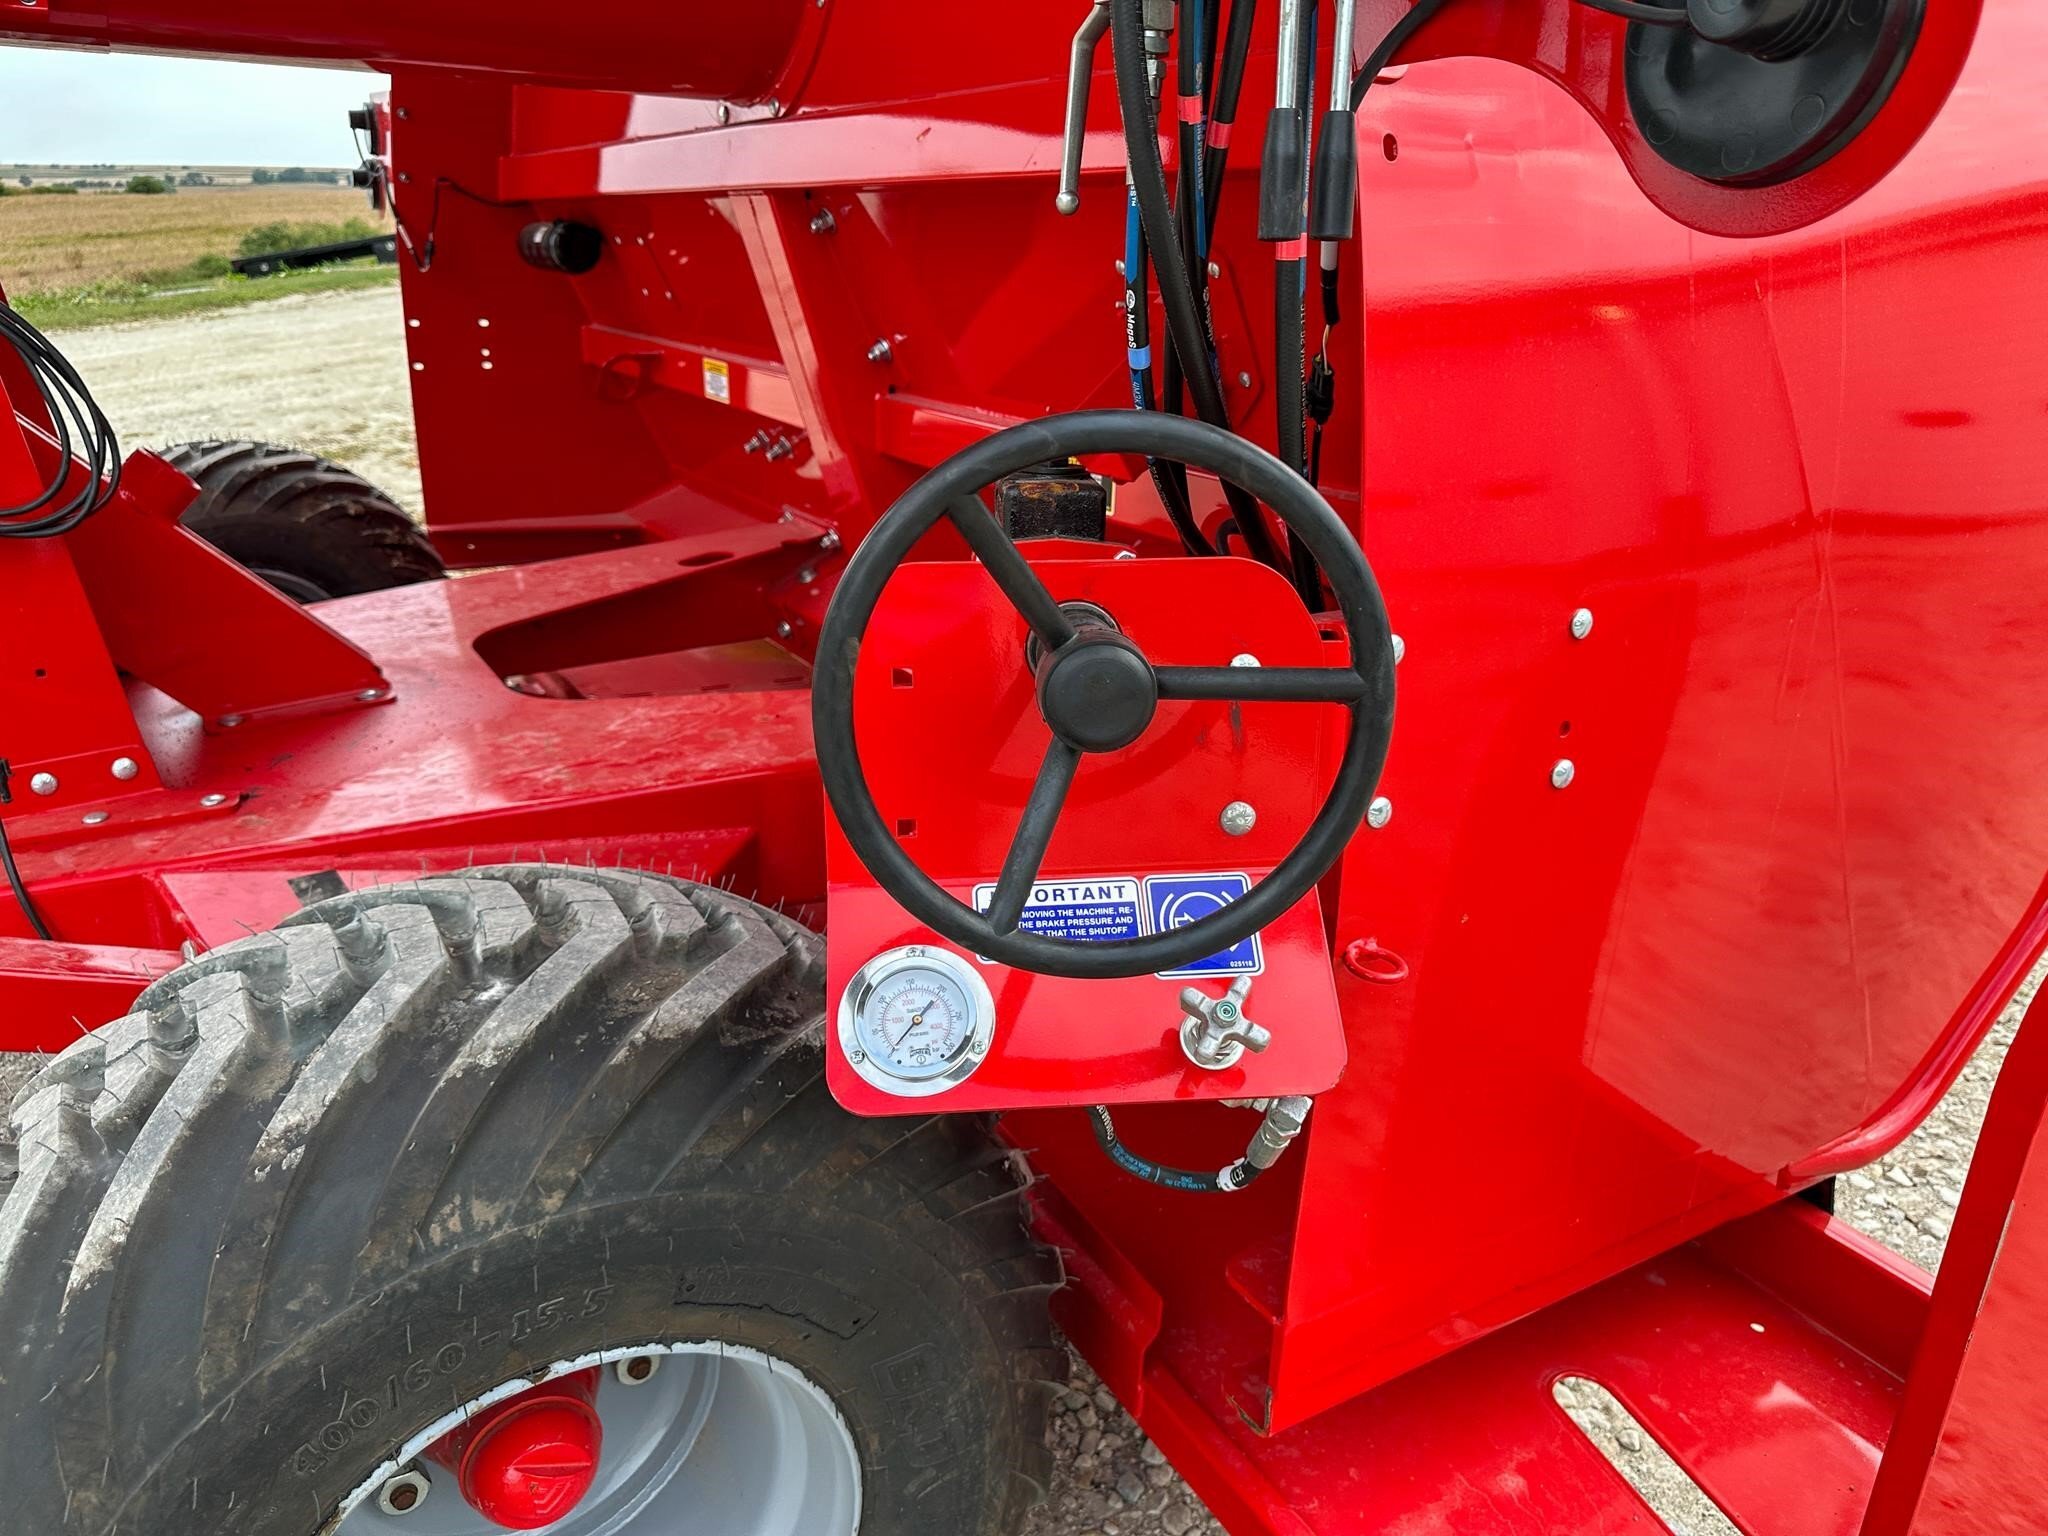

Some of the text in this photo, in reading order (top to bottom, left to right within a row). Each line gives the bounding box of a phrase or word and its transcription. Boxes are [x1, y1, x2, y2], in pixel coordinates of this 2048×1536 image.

[1126, 313, 1137, 349] MegaS
[991, 885, 1126, 903] ORTANT
[1021, 909, 1055, 919] MOVING
[1057, 908, 1074, 917] THE
[1119, 906, 1134, 915] RE-
[1035, 919, 1065, 928] BRAKE
[1067, 917, 1113, 927] PRESSURE
[1114, 916, 1133, 925] AND
[1046, 928, 1068, 937] THAT
[1070, 928, 1087, 937] THE
[1088, 926, 1128, 936] SHUTOFF
[1229, 960, 1253, 968] 025118
